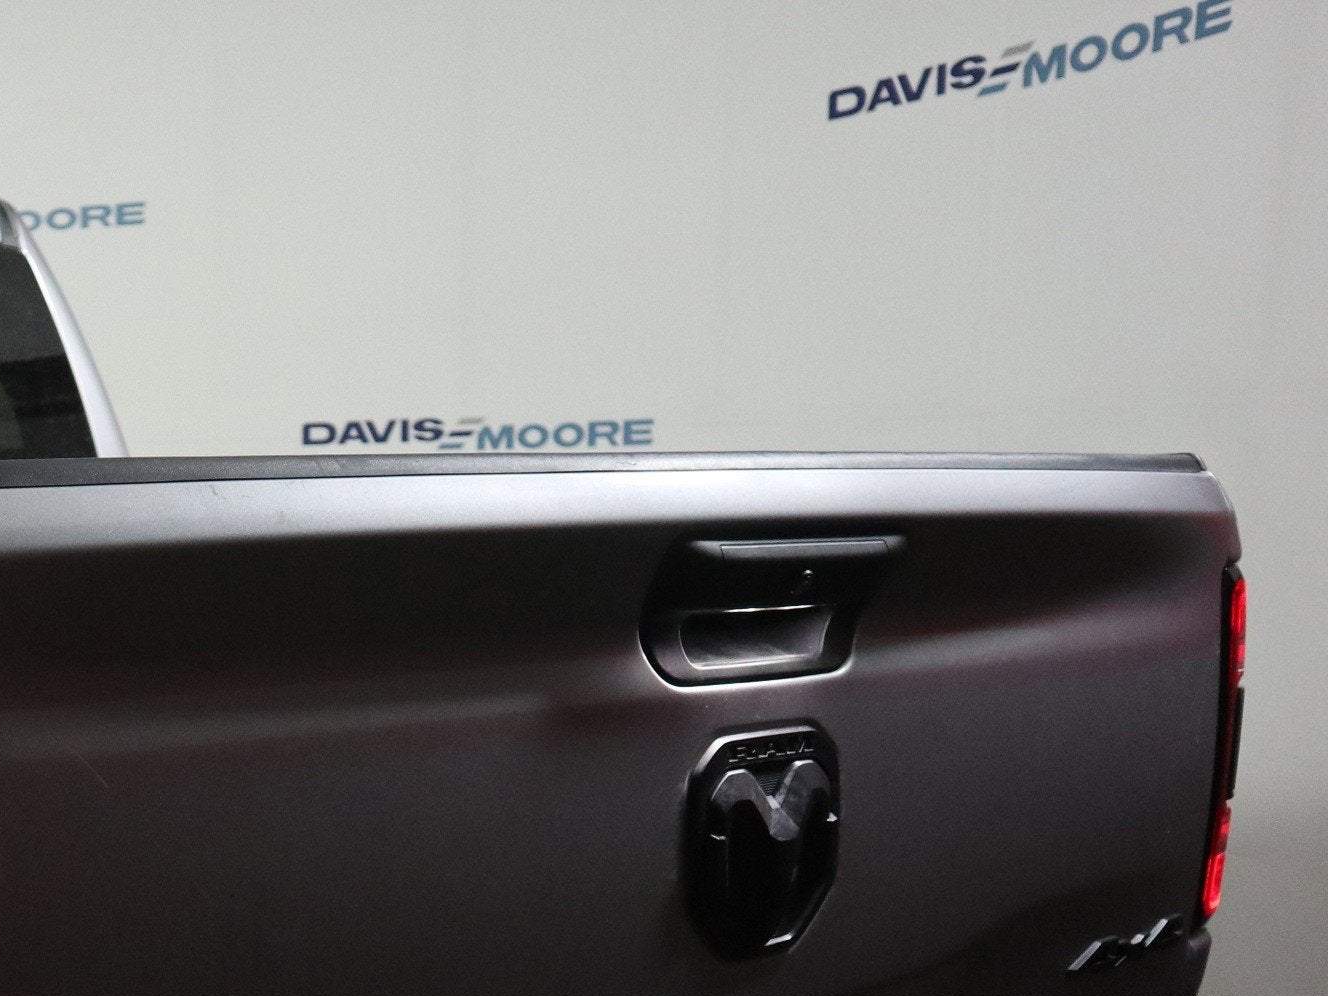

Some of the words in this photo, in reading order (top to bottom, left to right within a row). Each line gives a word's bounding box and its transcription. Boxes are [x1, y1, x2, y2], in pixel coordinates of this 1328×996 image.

[827, 54, 987, 121] DAVIS
[1022, 0, 1234, 88] MOORE
[302, 418, 444, 445] DAVIS
[477, 419, 655, 450] MOORE
